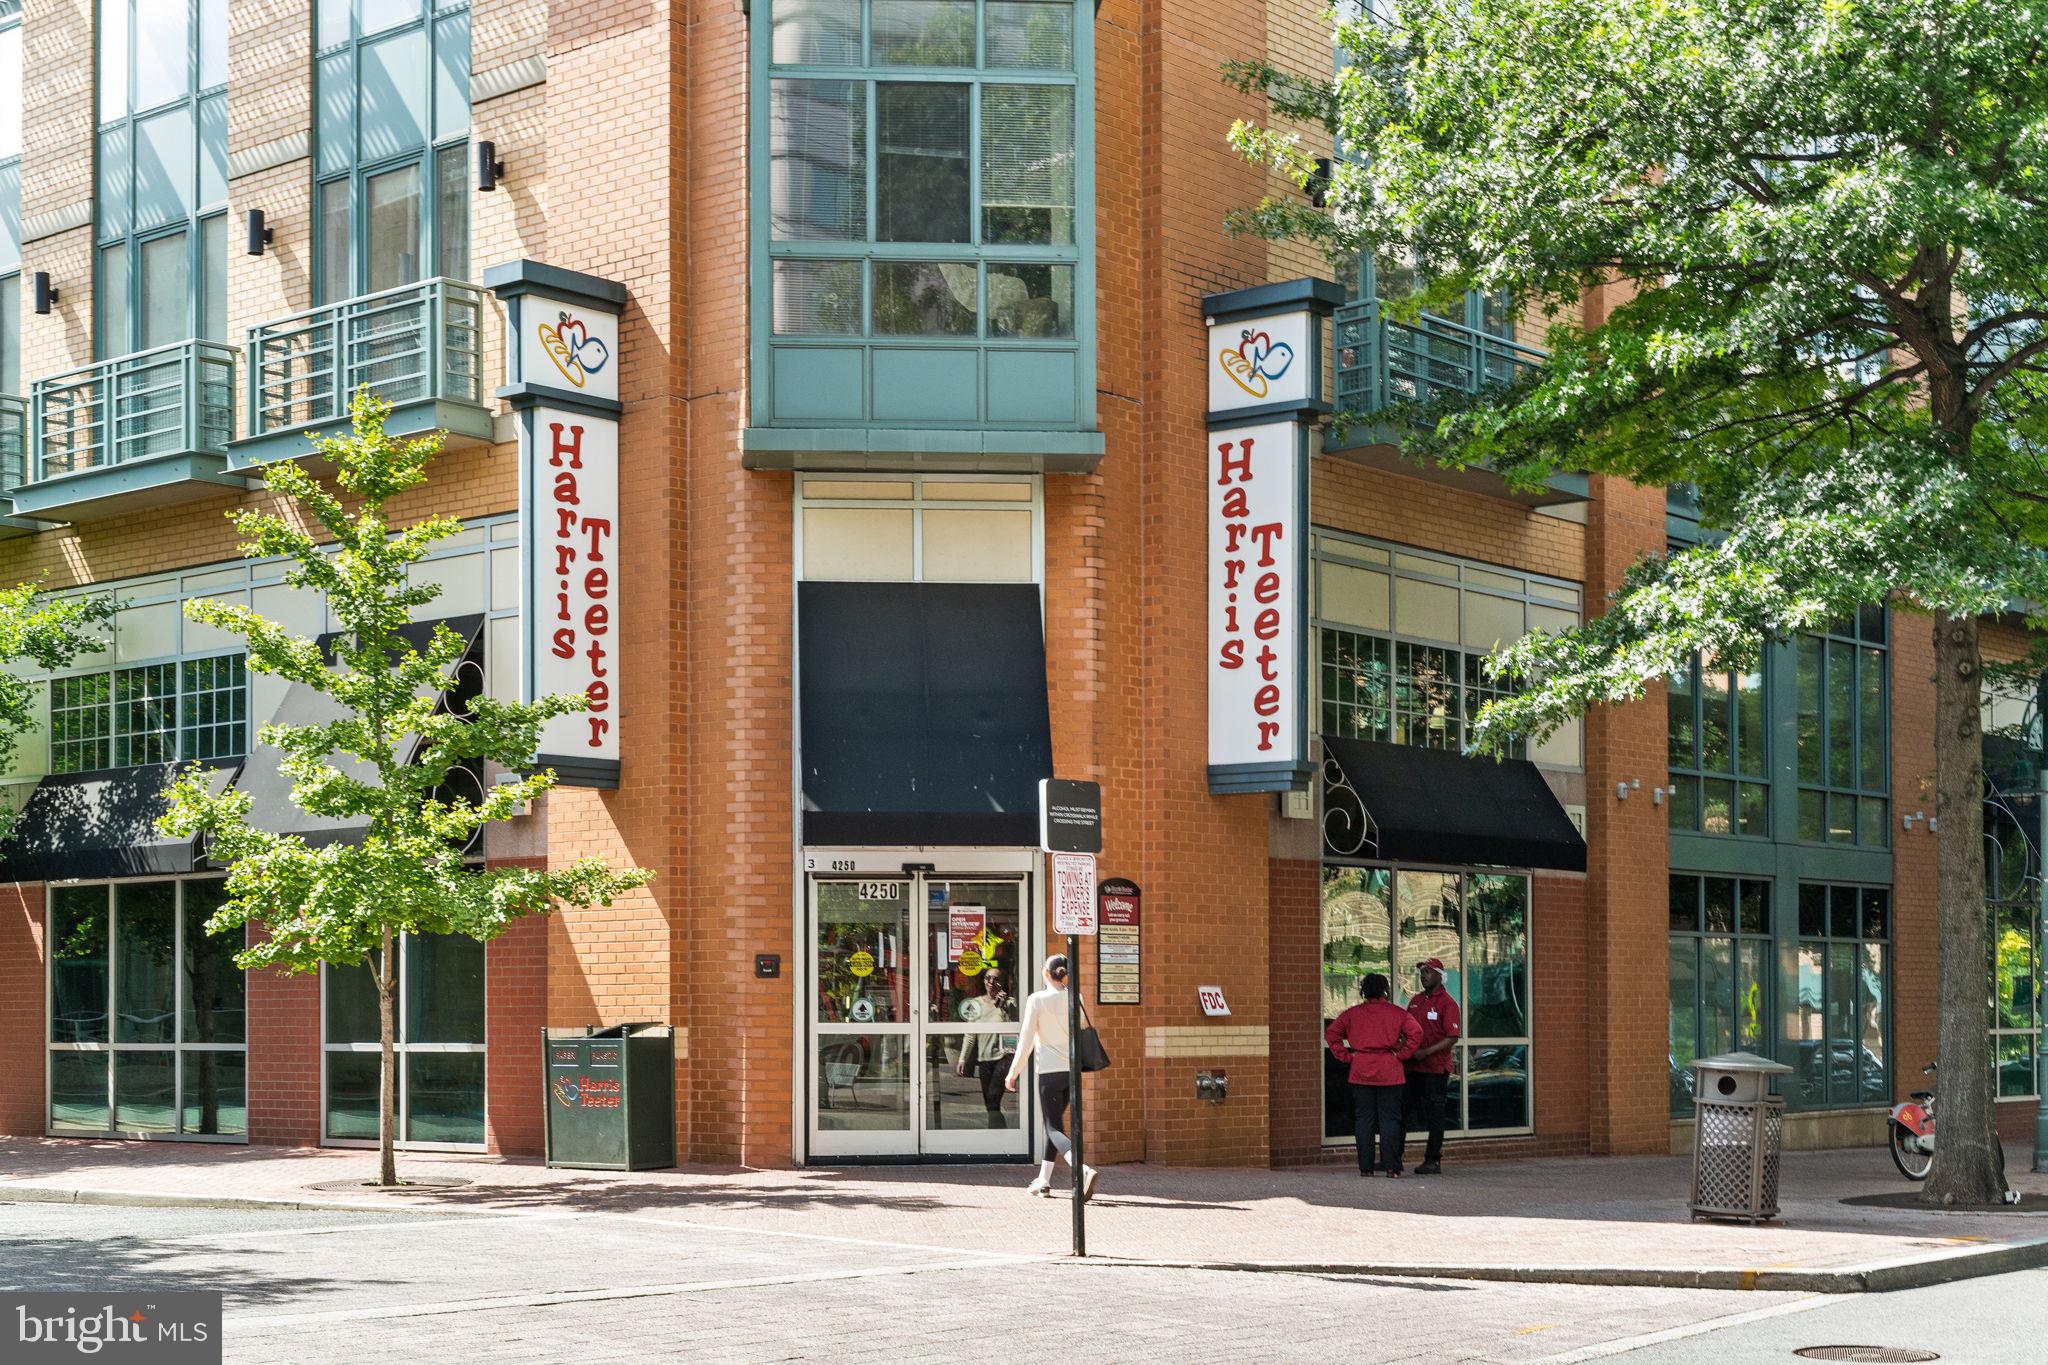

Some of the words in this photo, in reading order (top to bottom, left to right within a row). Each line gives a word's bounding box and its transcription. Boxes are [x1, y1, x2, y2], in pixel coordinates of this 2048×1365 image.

[549, 422, 585, 660] Harris
[1217, 437, 1255, 670] Harris
[581, 517, 611, 747] Teeter
[1251, 522, 1283, 751] Teeter
[807, 858, 815, 869] 3
[832, 860, 856, 871] 4250
[1057, 871, 1082, 886] TOWING
[1083, 871, 1092, 886] AT
[860, 883, 898, 899] 4250
[1060, 886, 1090, 900] OWNER'S
[1061, 900, 1090, 915] EXPENSE
[1104, 897, 1134, 913] Welcome
[1200, 991, 1225, 1010] FDC
[579, 1076, 621, 1092] Harris
[579, 1092, 621, 1108] Teeter
